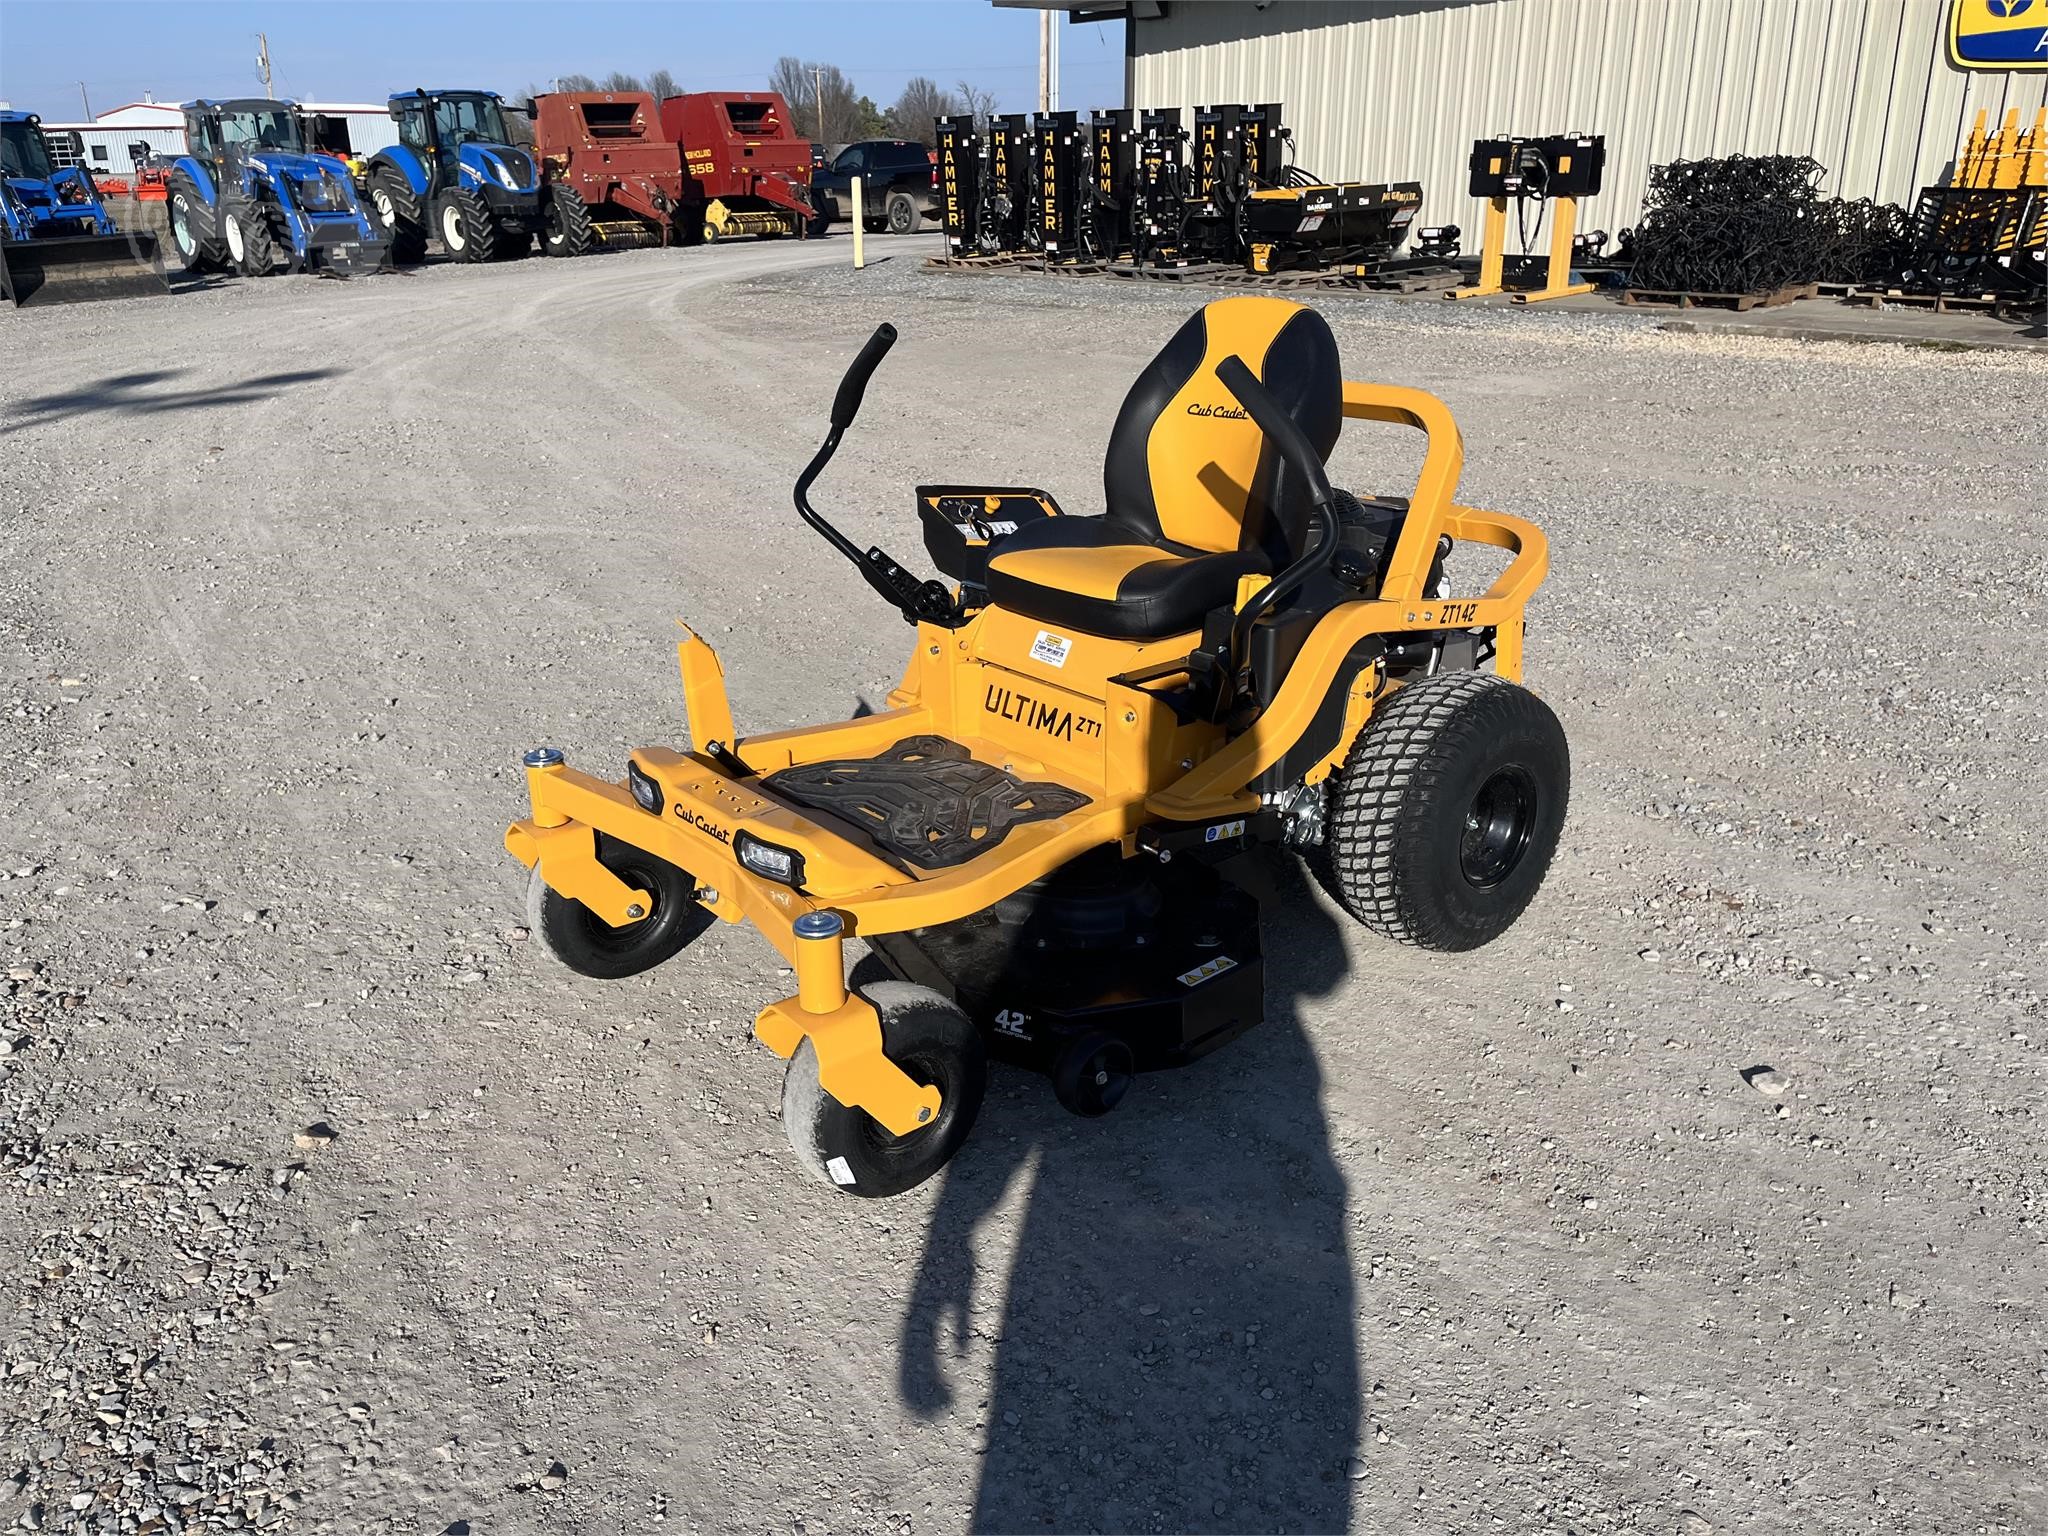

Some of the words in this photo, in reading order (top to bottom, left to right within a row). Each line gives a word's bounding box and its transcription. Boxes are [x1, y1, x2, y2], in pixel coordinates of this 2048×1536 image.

[943, 133, 959, 226] HAMMER
[1043, 130, 1056, 230] HAMMER
[1187, 403, 1212, 417] Cub
[1213, 406, 1249, 420] Cadet
[984, 684, 1073, 742] ULTIMA
[1075, 716, 1102, 738] ZT1
[674, 803, 695, 825] Cub
[695, 815, 731, 846] Cadet
